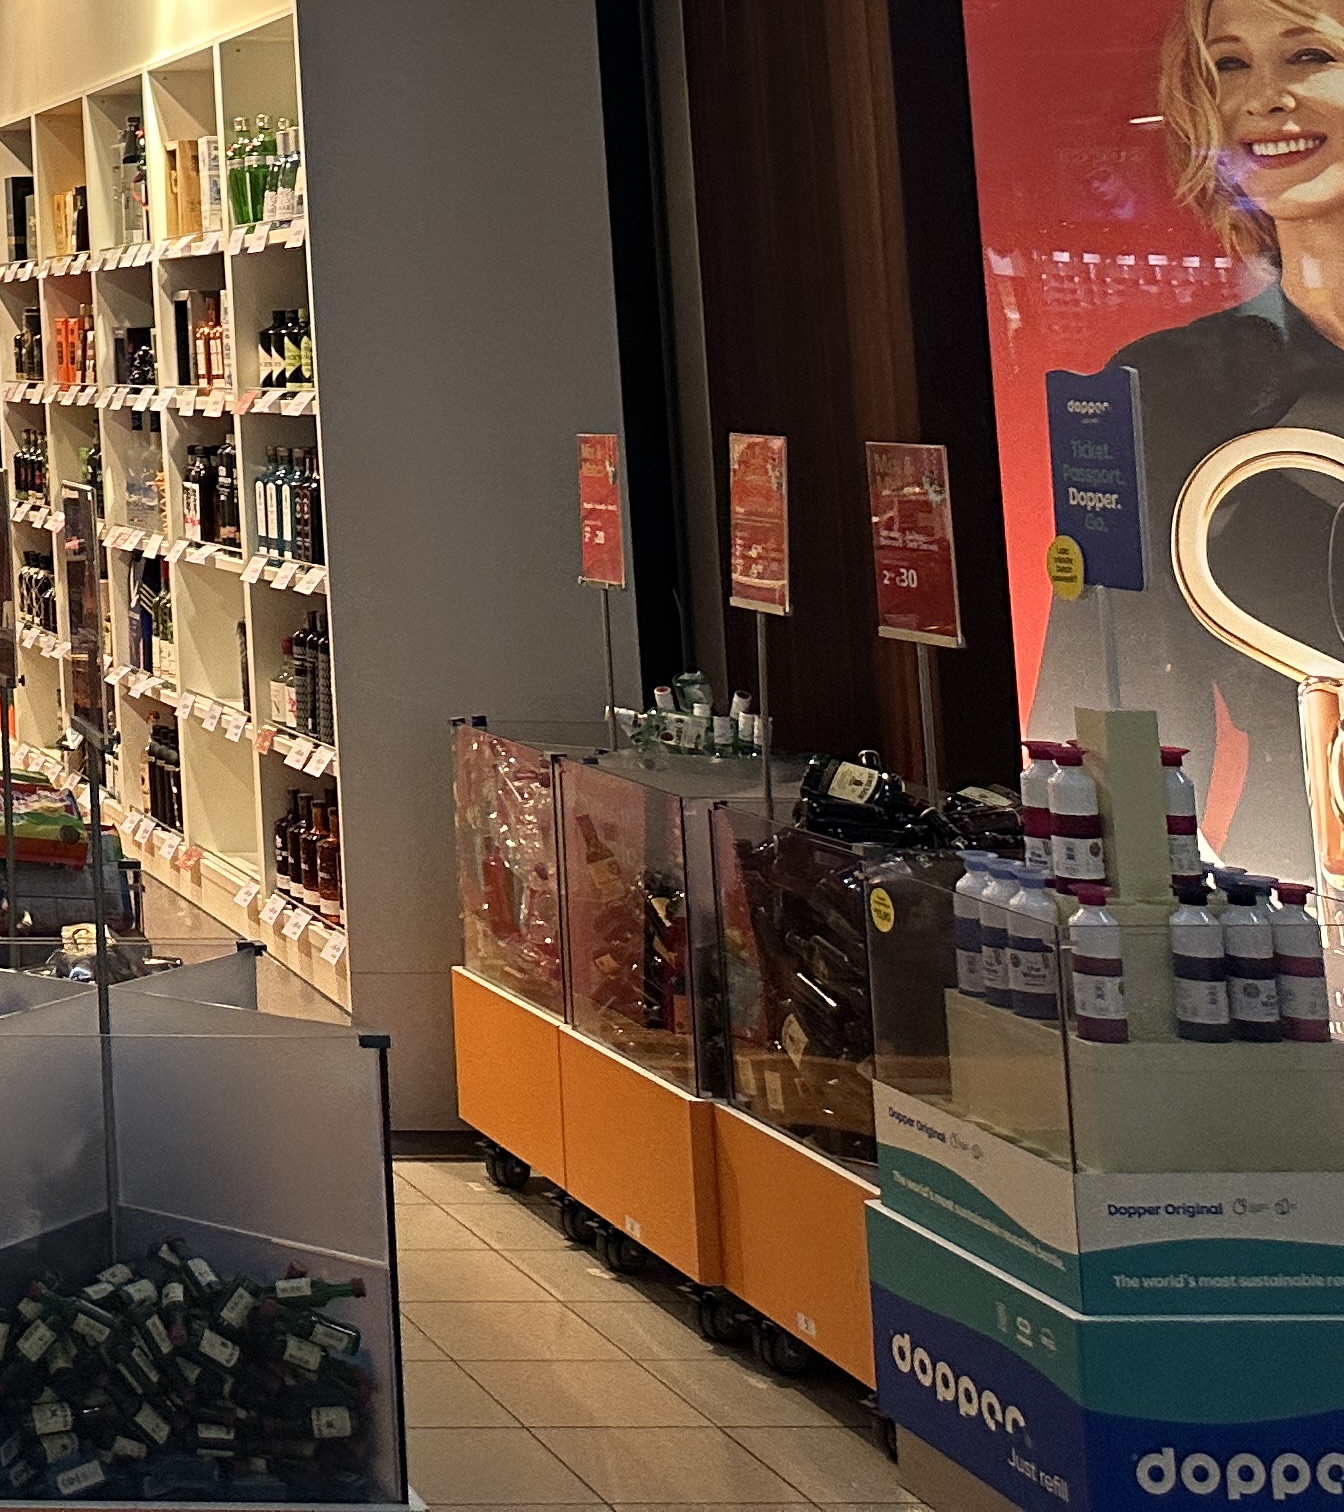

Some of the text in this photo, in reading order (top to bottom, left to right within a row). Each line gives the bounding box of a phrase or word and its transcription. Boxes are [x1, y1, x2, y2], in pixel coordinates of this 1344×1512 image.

[1067, 399, 1110, 415] dopper
[1068, 487, 1123, 512] Dopper.
[1107, 1202, 1224, 1219] Dopper Original
[1113, 1274, 1139, 1288] The
[1141, 1273, 1196, 1289] world's
[1199, 1275, 1236, 1288] most
[1238, 1273, 1325, 1288] sustainable
[892, 1332, 1026, 1434] dopper
[1007, 1447, 1070, 1503] Just refill
